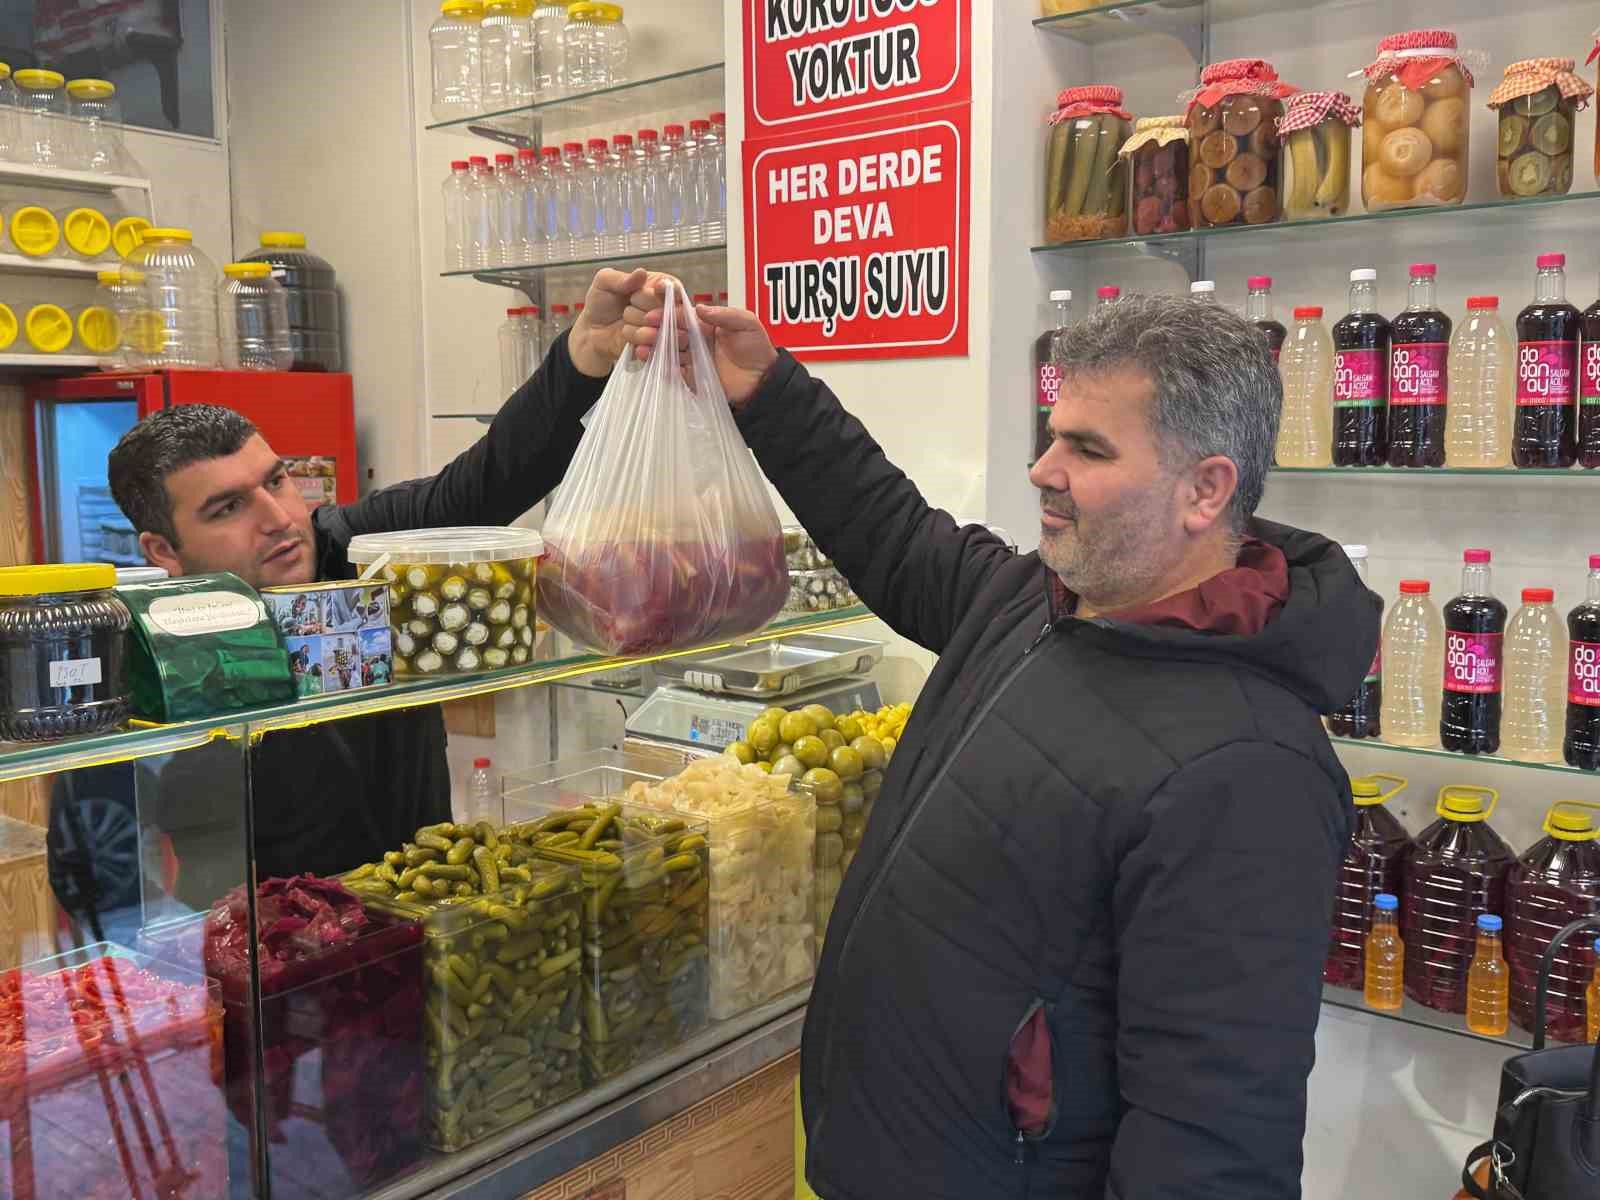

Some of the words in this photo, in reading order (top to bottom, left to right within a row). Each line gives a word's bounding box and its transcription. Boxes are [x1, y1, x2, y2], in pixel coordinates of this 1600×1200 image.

[788, 28, 918, 102] YOKTUR
[768, 163, 829, 205] HER
[837, 144, 943, 196] DERDE
[813, 201, 894, 245] DEVA
[766, 259, 858, 333] TURŞU
[867, 249, 946, 316] SUYU
[1393, 347, 1409, 364] do
[1521, 344, 1538, 362] do
[1041, 363, 1056, 378] do
[1334, 368, 1353, 383] an
[1393, 364, 1419, 382] gan
[1520, 363, 1549, 381] gan
[1399, 379, 1418, 396] ay
[1527, 378, 1549, 396] ay
[1449, 634, 1466, 651] do
[1448, 650, 1476, 668] gan
[1575, 644, 1595, 662] do
[1455, 666, 1476, 684] ay
